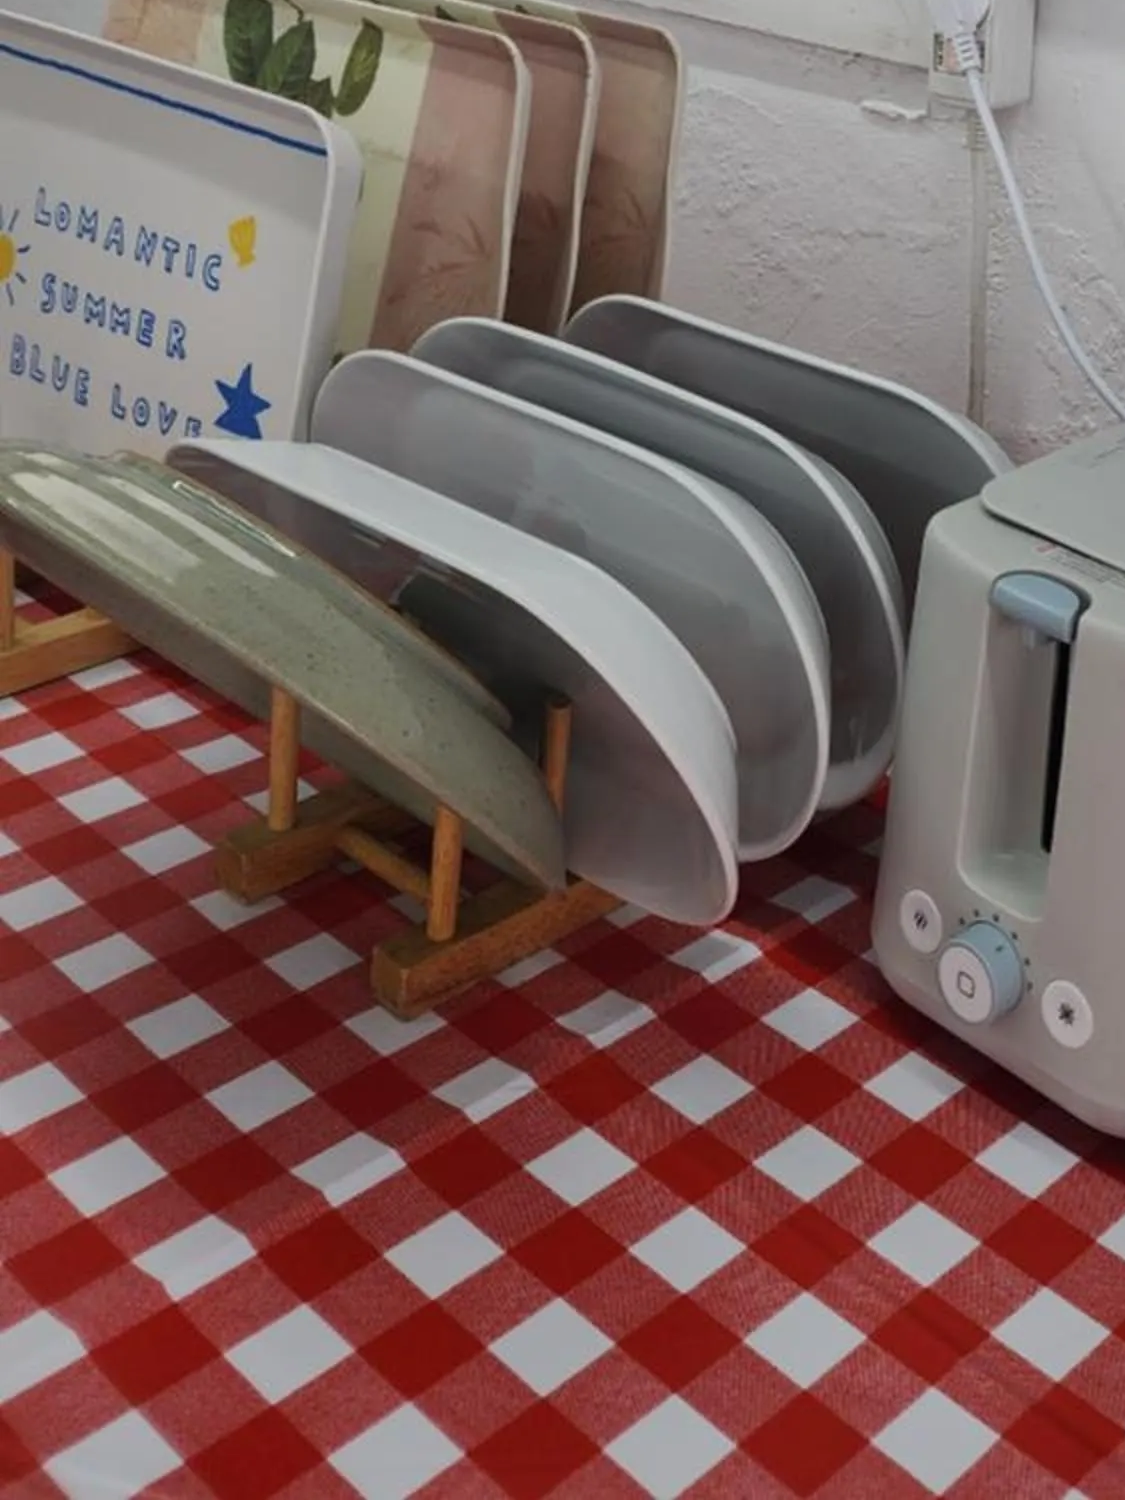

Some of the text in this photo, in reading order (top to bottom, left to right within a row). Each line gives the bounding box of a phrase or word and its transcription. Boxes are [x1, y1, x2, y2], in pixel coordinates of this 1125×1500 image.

[34, 187, 223, 292] LOMANTIC
[41, 272, 188, 360] SUMMER
[9, 333, 203, 438] BLUE LOVE
